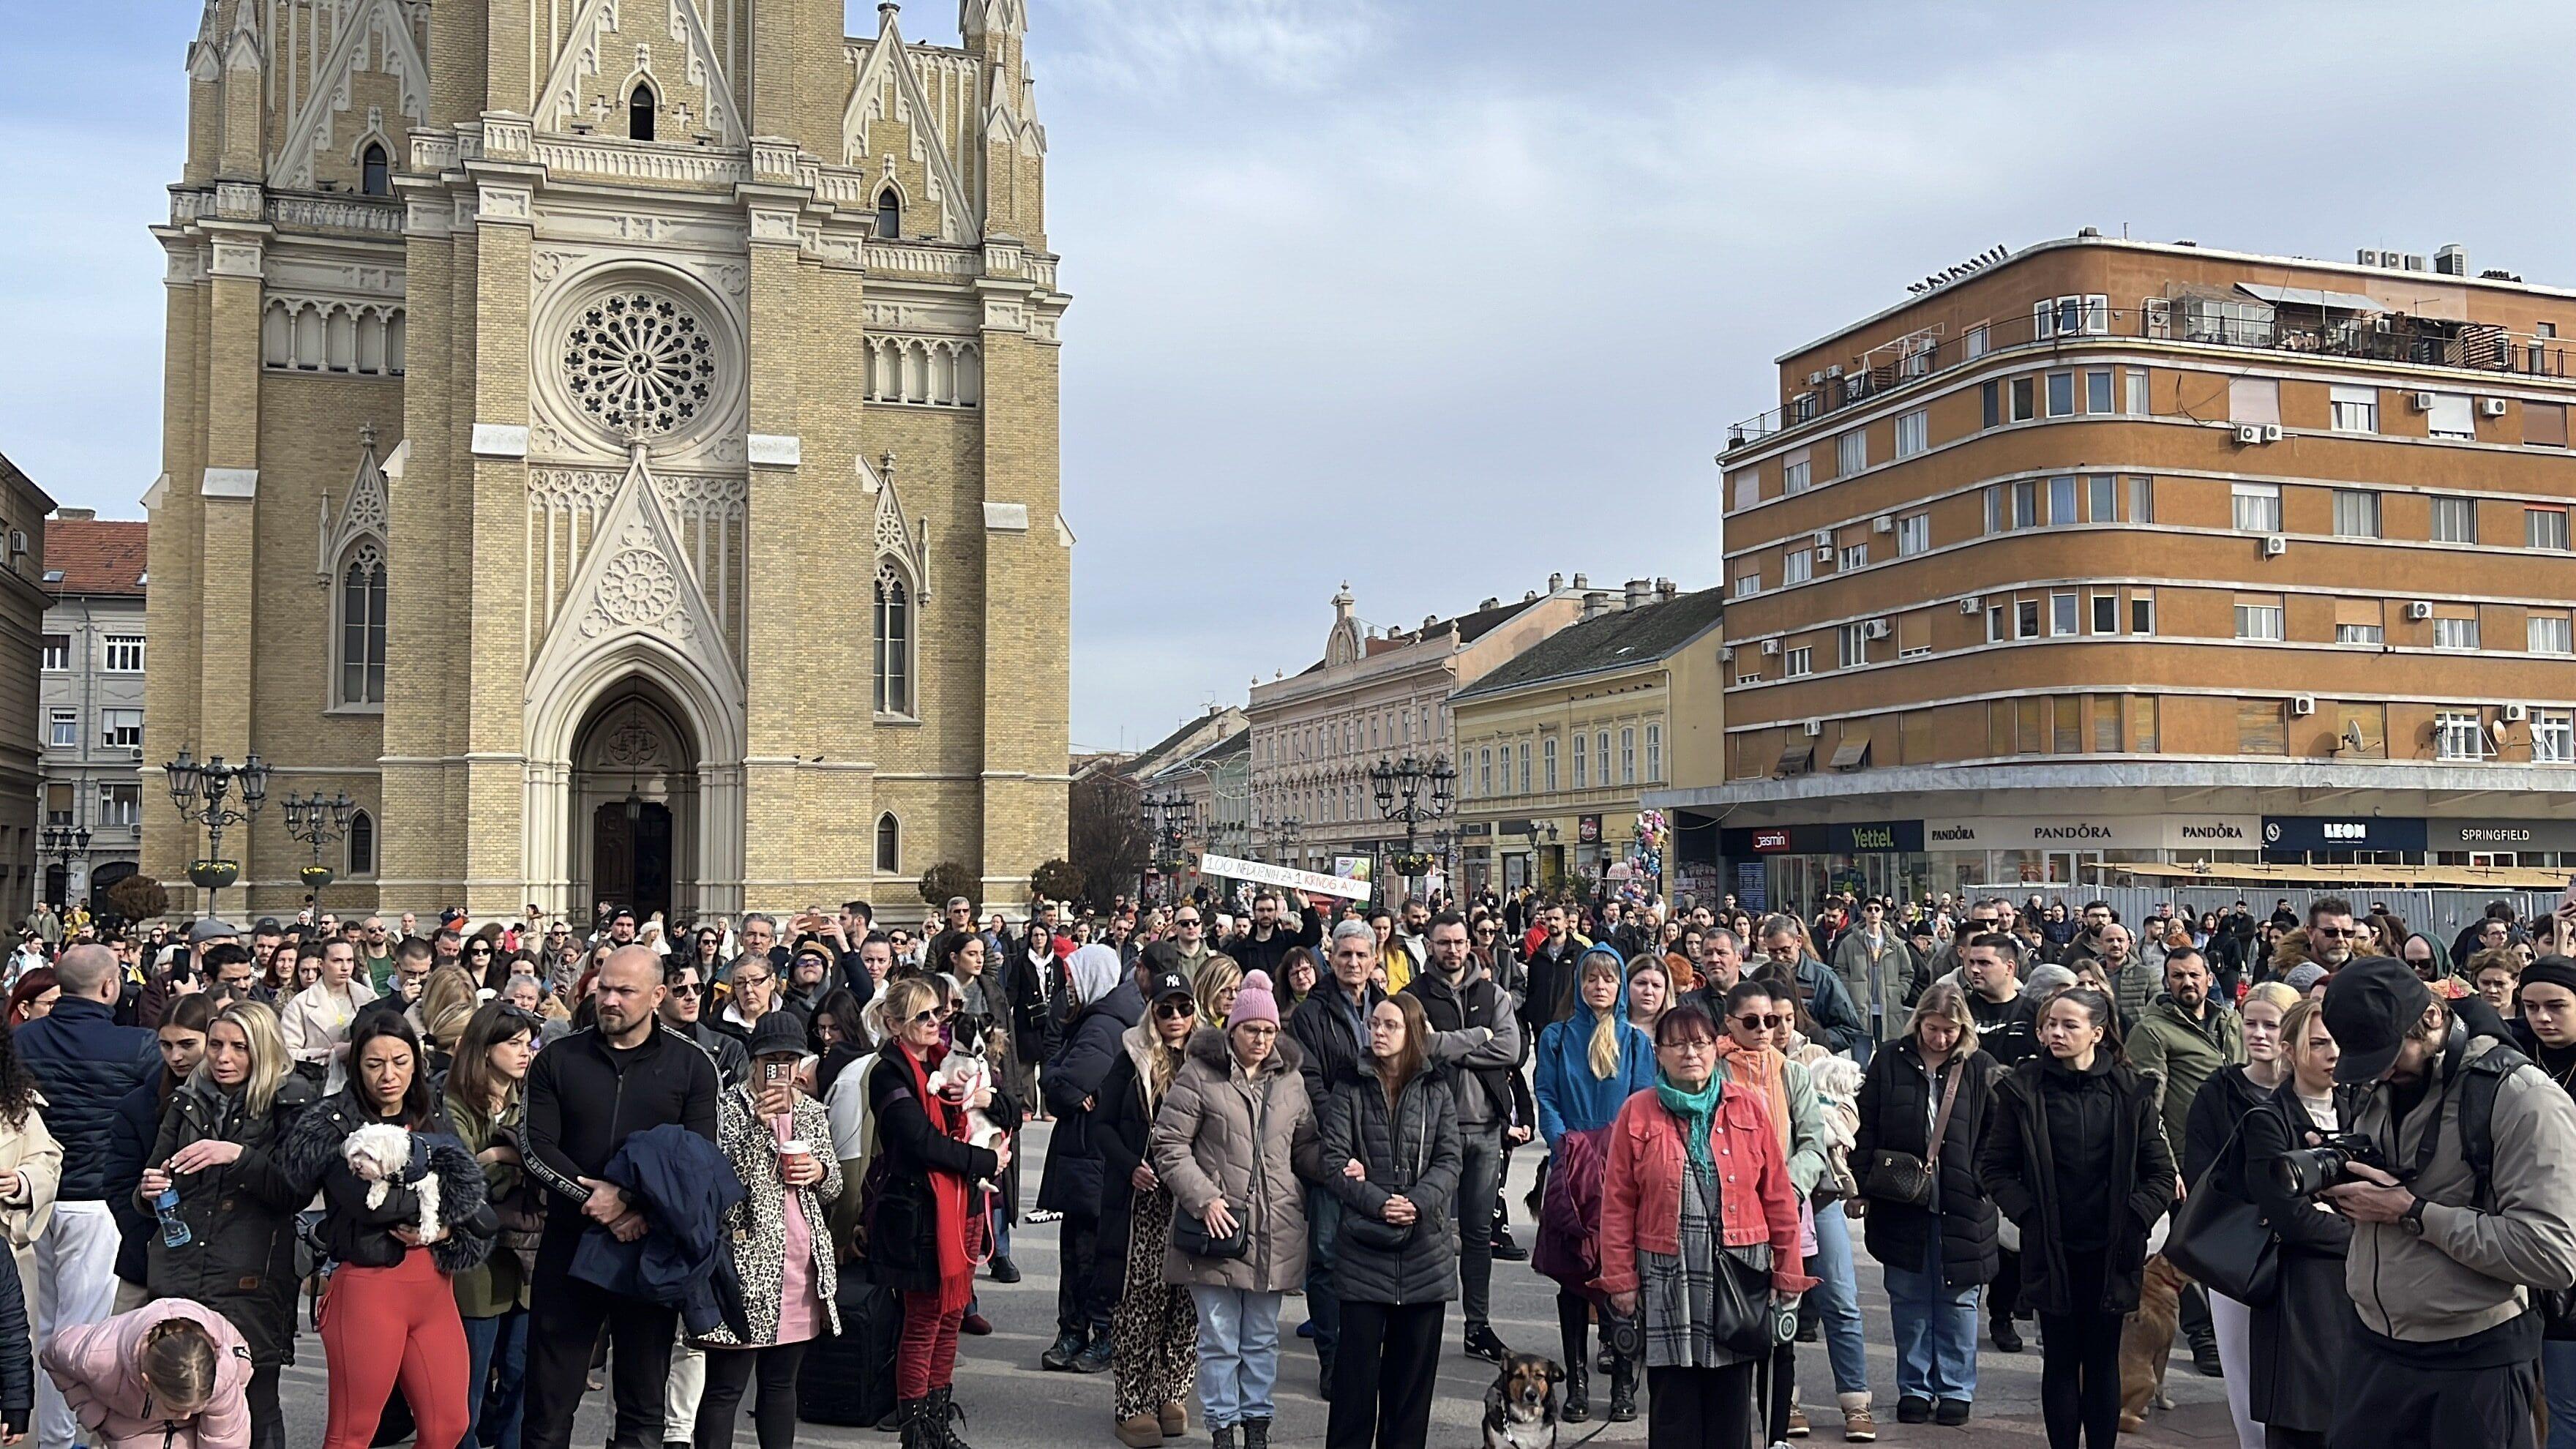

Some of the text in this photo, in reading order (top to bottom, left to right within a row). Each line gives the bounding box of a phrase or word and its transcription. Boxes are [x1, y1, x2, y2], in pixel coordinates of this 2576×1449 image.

[1932, 826, 1975, 841] PANDORA
[2034, 825, 2111, 839] PANDORA
[2183, 824, 2243, 839] PANDORA
[2324, 823, 2366, 839] LEON
[2461, 829, 2530, 841] SPRINGFIELD
[1206, 856, 1233, 872] 100
[1281, 870, 1292, 883] ZA
[1295, 872, 1302, 884] 1
[527, 1156, 554, 1183] GUESS
